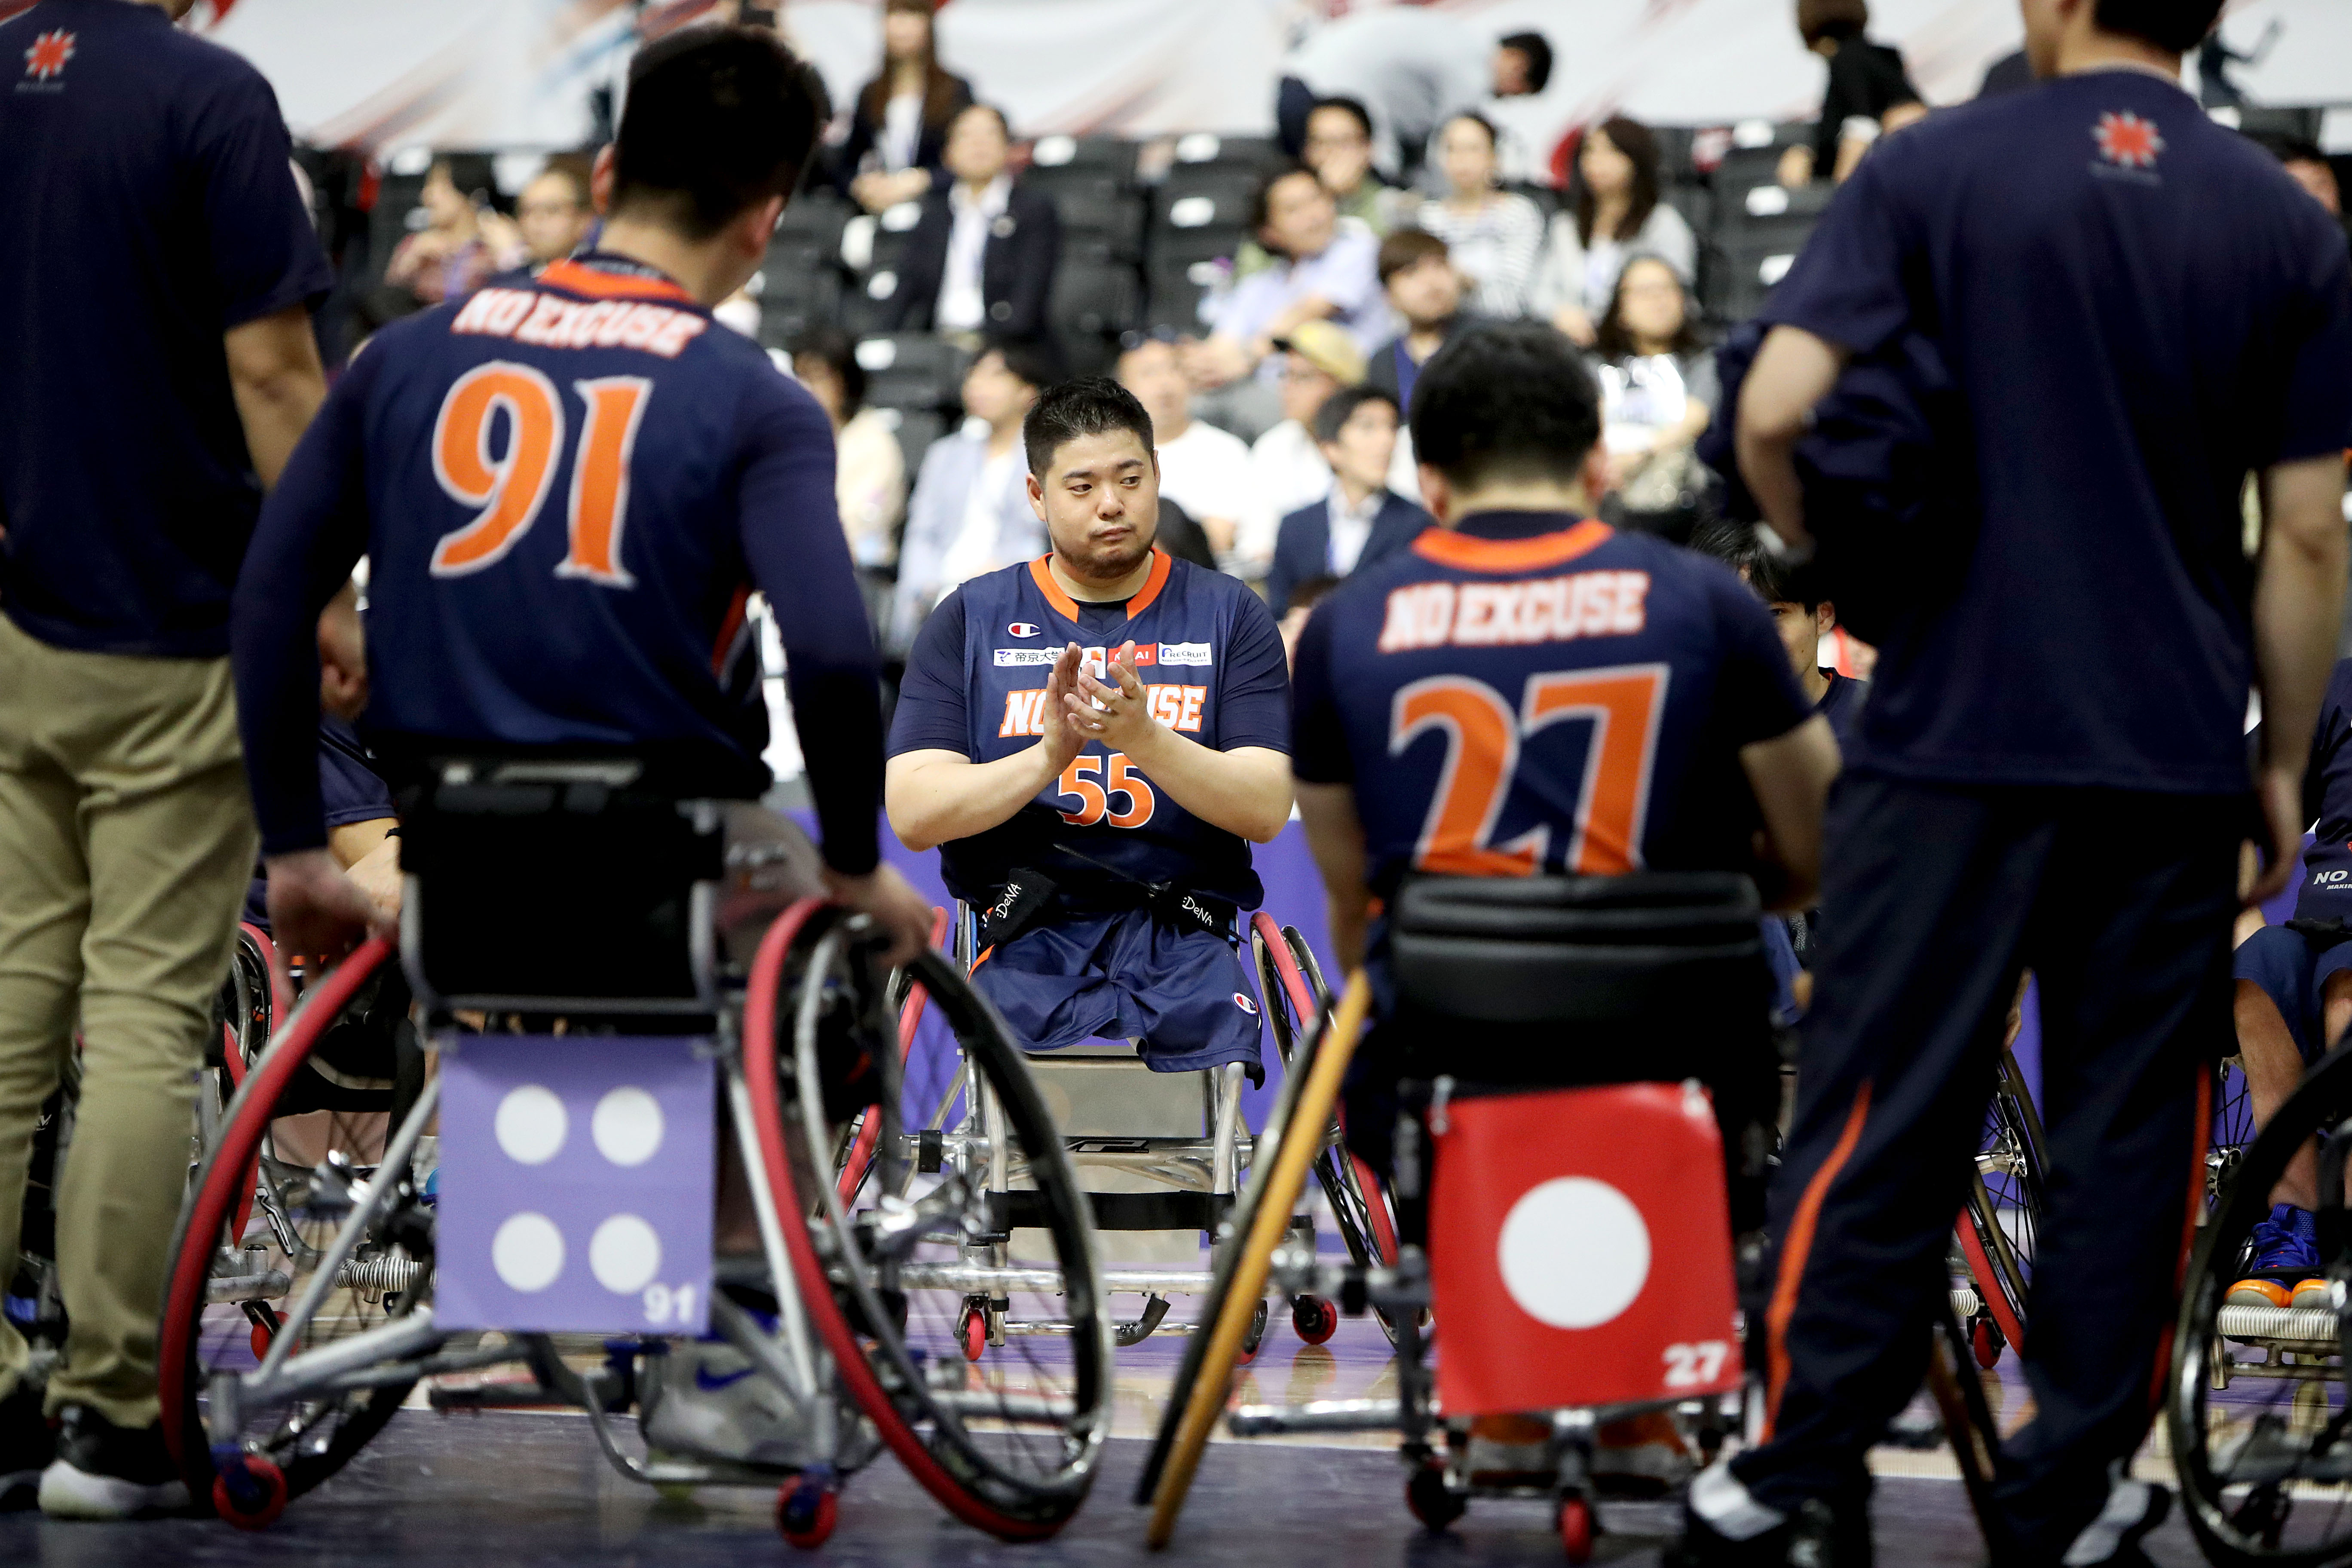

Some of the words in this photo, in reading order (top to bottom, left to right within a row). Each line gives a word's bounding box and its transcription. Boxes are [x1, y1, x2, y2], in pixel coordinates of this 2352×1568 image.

[450, 288, 538, 337] NO
[515, 292, 708, 359] EXCUSE
[429, 358, 654, 591] 91
[1378, 582, 1456, 654] NO
[1450, 569, 1651, 646] EXCUSE
[1114, 651, 1149, 662] KAI
[1056, 752, 1155, 829] 55
[1389, 662, 1671, 877] 27
[2313, 870, 2348, 885] NO
[644, 1283, 695, 1324] 91
[1661, 1340, 1727, 1387] 27
